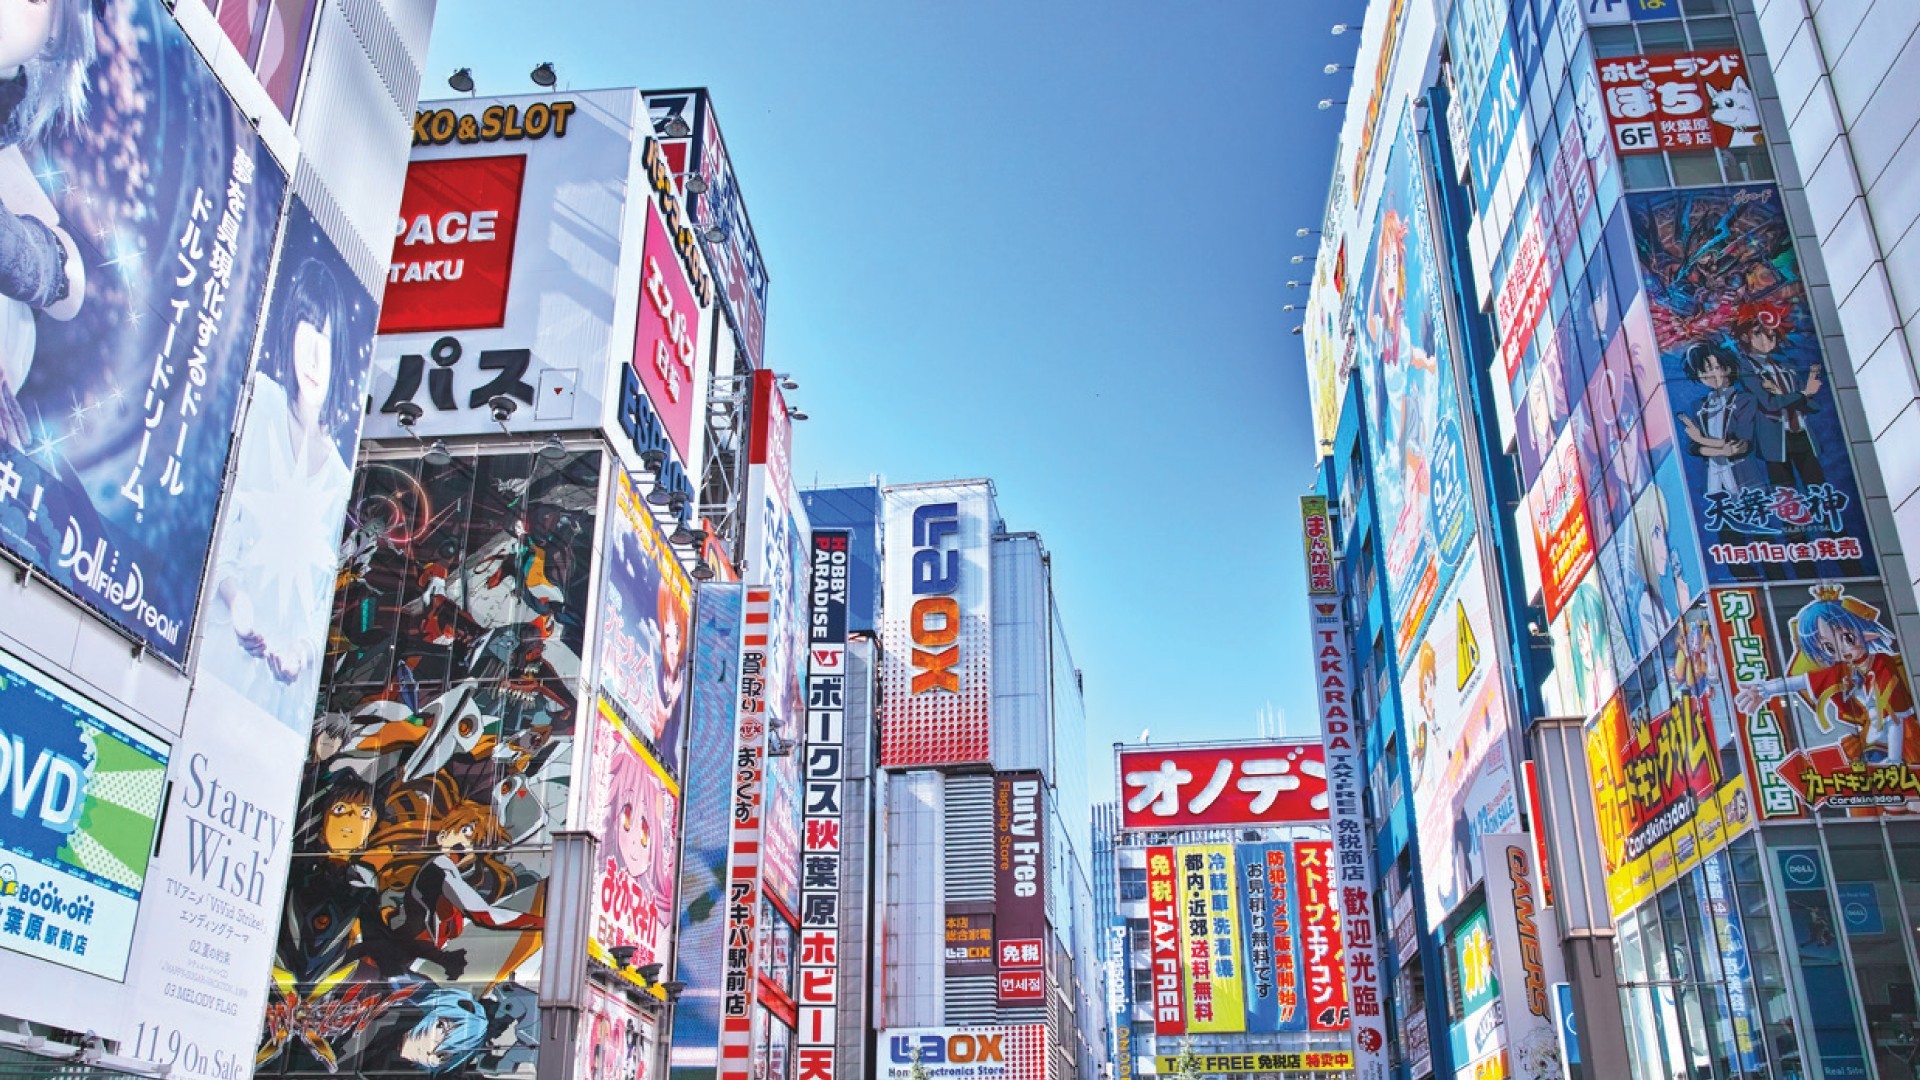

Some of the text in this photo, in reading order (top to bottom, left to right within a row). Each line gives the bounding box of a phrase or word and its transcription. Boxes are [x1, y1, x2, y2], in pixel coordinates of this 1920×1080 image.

[1601, 54, 1740, 82] ホビーランド
[1606, 78, 1704, 118] ぽち
[1620, 127, 1653, 146] 6F
[1660, 118, 1711, 133] 秋葉原
[366, 335, 535, 413] パス
[812, 537, 831, 638] PARADISE
[831, 537, 847, 605] HOBBY
[1317, 630, 1351, 750] TAKARADA
[182, 752, 285, 865] Starry
[998, 781, 1012, 870] Flagship Store
[1011, 781, 1040, 897] Duty Free
[186, 815, 264, 907] Wish
[0, 905, 88, 956] 葉原駅前店
[725, 881, 750, 1017] アキバ駅前店
[1150, 854, 1180, 1023] 免税 TAX FREE
[1505, 845, 1551, 1022] GAMERS
[184, 1041, 208, 1076] On
[1206, 1056, 1254, 1070] FREE
[1258, 1054, 1301, 1069] 免税店
